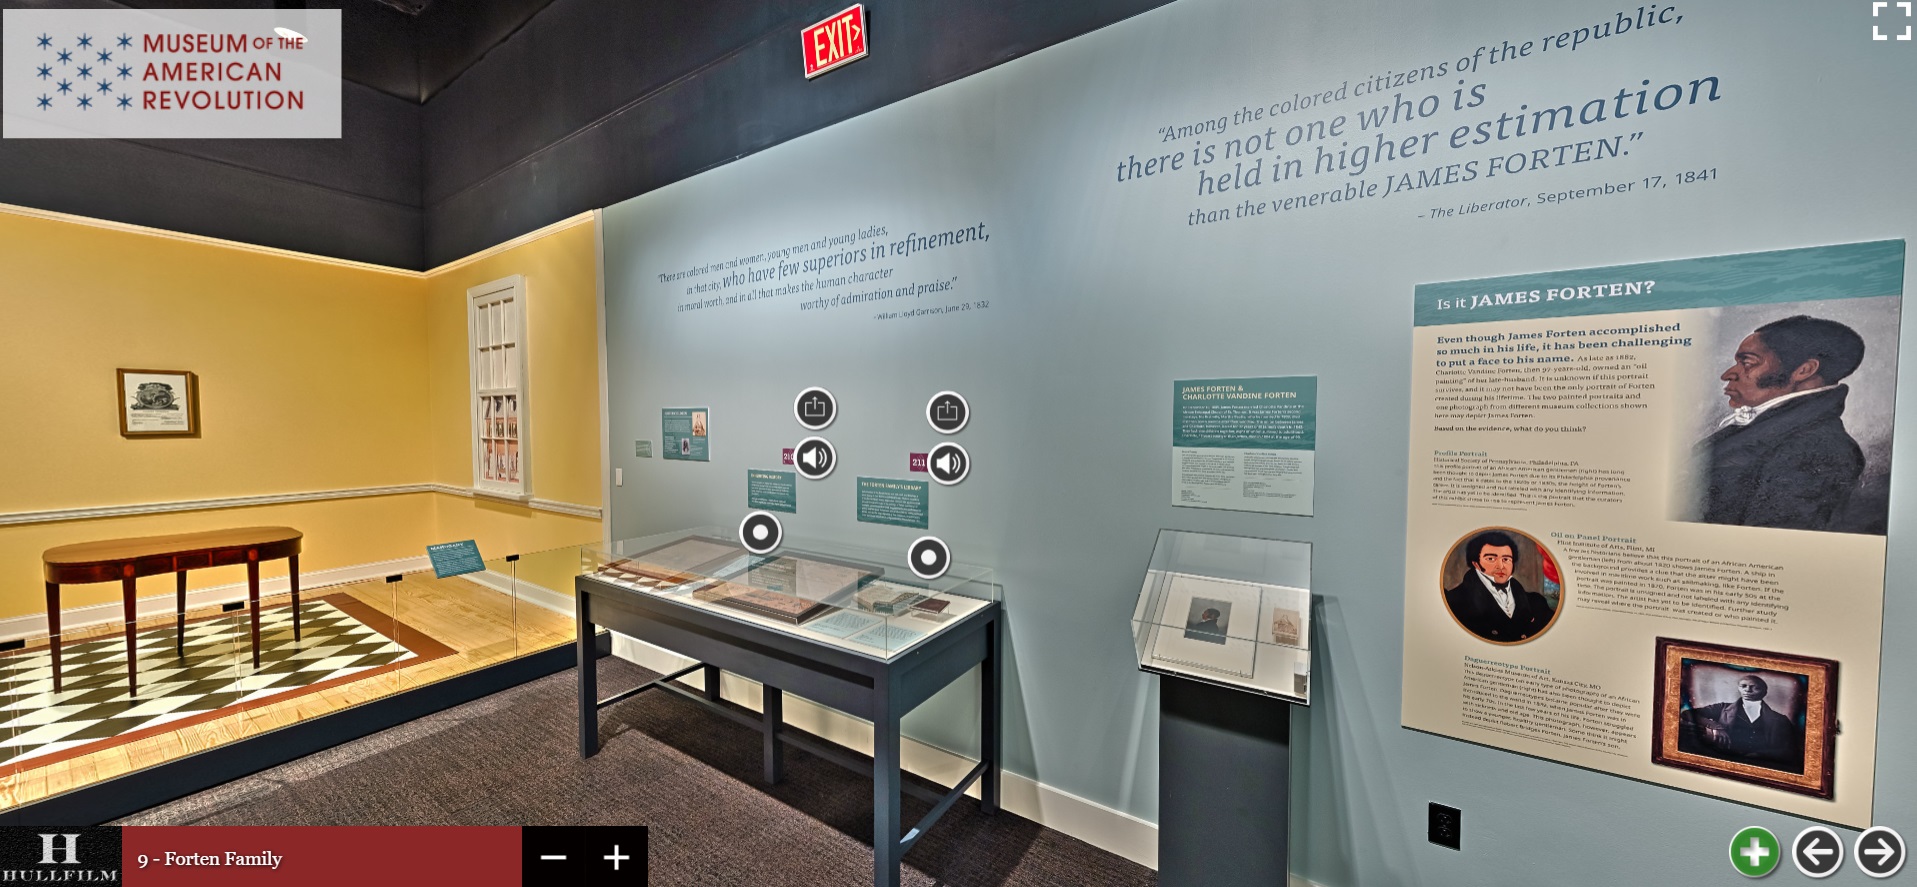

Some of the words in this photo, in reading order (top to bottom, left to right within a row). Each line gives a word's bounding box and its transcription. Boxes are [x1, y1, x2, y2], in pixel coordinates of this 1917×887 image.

[813, 14, 853, 68] EXIT
[1158, 116, 1227, 142] “Among
[1233, 106, 1264, 126] the
[1269, 81, 1348, 117] colored
[1354, 60, 1449, 97] citizens
[1456, 47, 1486, 72] of
[1489, 41, 1534, 65] the
[1542, 4, 1683, 51] republic,
[1117, 152, 1185, 182] there
[1193, 141, 1215, 166] is
[1225, 127, 1277, 159] not
[1285, 114, 1346, 146] one
[1358, 93, 1439, 131] who
[1453, 79, 1486, 111] is
[1198, 158, 1262, 196] held
[1272, 155, 1303, 182] in
[1315, 131, 1438, 176] higher
[1449, 75, 1721, 149] estimation
[1188, 208, 1230, 226] than
[1236, 200, 1266, 219] the
[1272, 179, 1378, 212] venerable
[1382, 160, 1478, 198] JAMES
[1486, 131, 1644, 178] FORTEN.”
[1430, 206, 1454, 219] The
[1458, 196, 1531, 216] Liberator,
[1537, 180, 1636, 205] September
[1642, 176, 1667, 190] 17,
[1675, 167, 1718, 185] 1841
[676, 271, 686, 280] are
[686, 263, 709, 277] colored
[710, 263, 724, 272] men
[725, 257, 738, 269] and
[739, 253, 767, 266] women,
[767, 248, 791, 262] young
[792, 243, 809, 254] men
[810, 236, 827, 250] and
[829, 233, 856, 249] young
[858, 225, 889, 240] ladies,
[686, 287, 693, 295] in
[694, 283, 707, 294] that
[723, 271, 746, 288] who
[748, 267, 776, 283] have
[778, 259, 800, 280] few
[802, 248, 867, 275] superiors
[871, 241, 886, 260] in
[890, 222, 990, 257] refinement,
[677, 302, 684, 312] in
[684, 298, 703, 311] moral
[725, 293, 738, 305] and
[739, 293, 746, 302] in
[747, 289, 757, 301] all
[758, 288, 773, 299] that
[775, 283, 800, 296] makes
[801, 280, 814, 292] the
[815, 278, 846, 290] human
[847, 268, 894, 284] character
[800, 296, 829, 311] worthy
[830, 293, 841, 308] of
[841, 288, 893, 305] admiration
[895, 282, 915, 298] and
[917, 276, 958, 298] praise.”
[1437, 298, 1451, 310] Is
[1455, 297, 1467, 309] it
[1470, 290, 1541, 310] JAMES
[1546, 280, 1656, 302] FORTEN?
[944, 304, 960, 313] June
[1436, 335, 1463, 344] Even
[1465, 333, 1505, 343] though
[1507, 332, 1543, 342] James
[1545, 329, 1586, 339] Forten
[1589, 323, 1681, 336] accomplished
[1449, 346, 1480, 355] much
[1483, 345, 1494, 353] in
[1496, 344, 1514, 353] his
[1516, 343, 1540, 353] life,
[1542, 342, 1552, 350] it
[1554, 341, 1575, 350] has
[1578, 340, 1609, 349] been
[1611, 336, 1693, 348] challenging
[1448, 359, 1467, 368] put
[1477, 357, 1500, 366] face
[1502, 357, 1514, 365] to
[1516, 355, 1535, 364] his
[1536, 355, 1574, 363] name.
[1182, 386, 1205, 394] JAMES
[1226, 392, 1262, 400] VANDINE
[1264, 391, 1297, 399] FORTEN
[1478, 425, 1512, 433] evidence,
[1560, 425, 1587, 433] think?
[912, 458, 926, 467] 211
[1576, 533, 1600, 541] Panel
[1602, 535, 1637, 544] Portrait
[1464, 655, 1519, 670] Daguerreotype
[1520, 664, 1551, 675] Portrait
